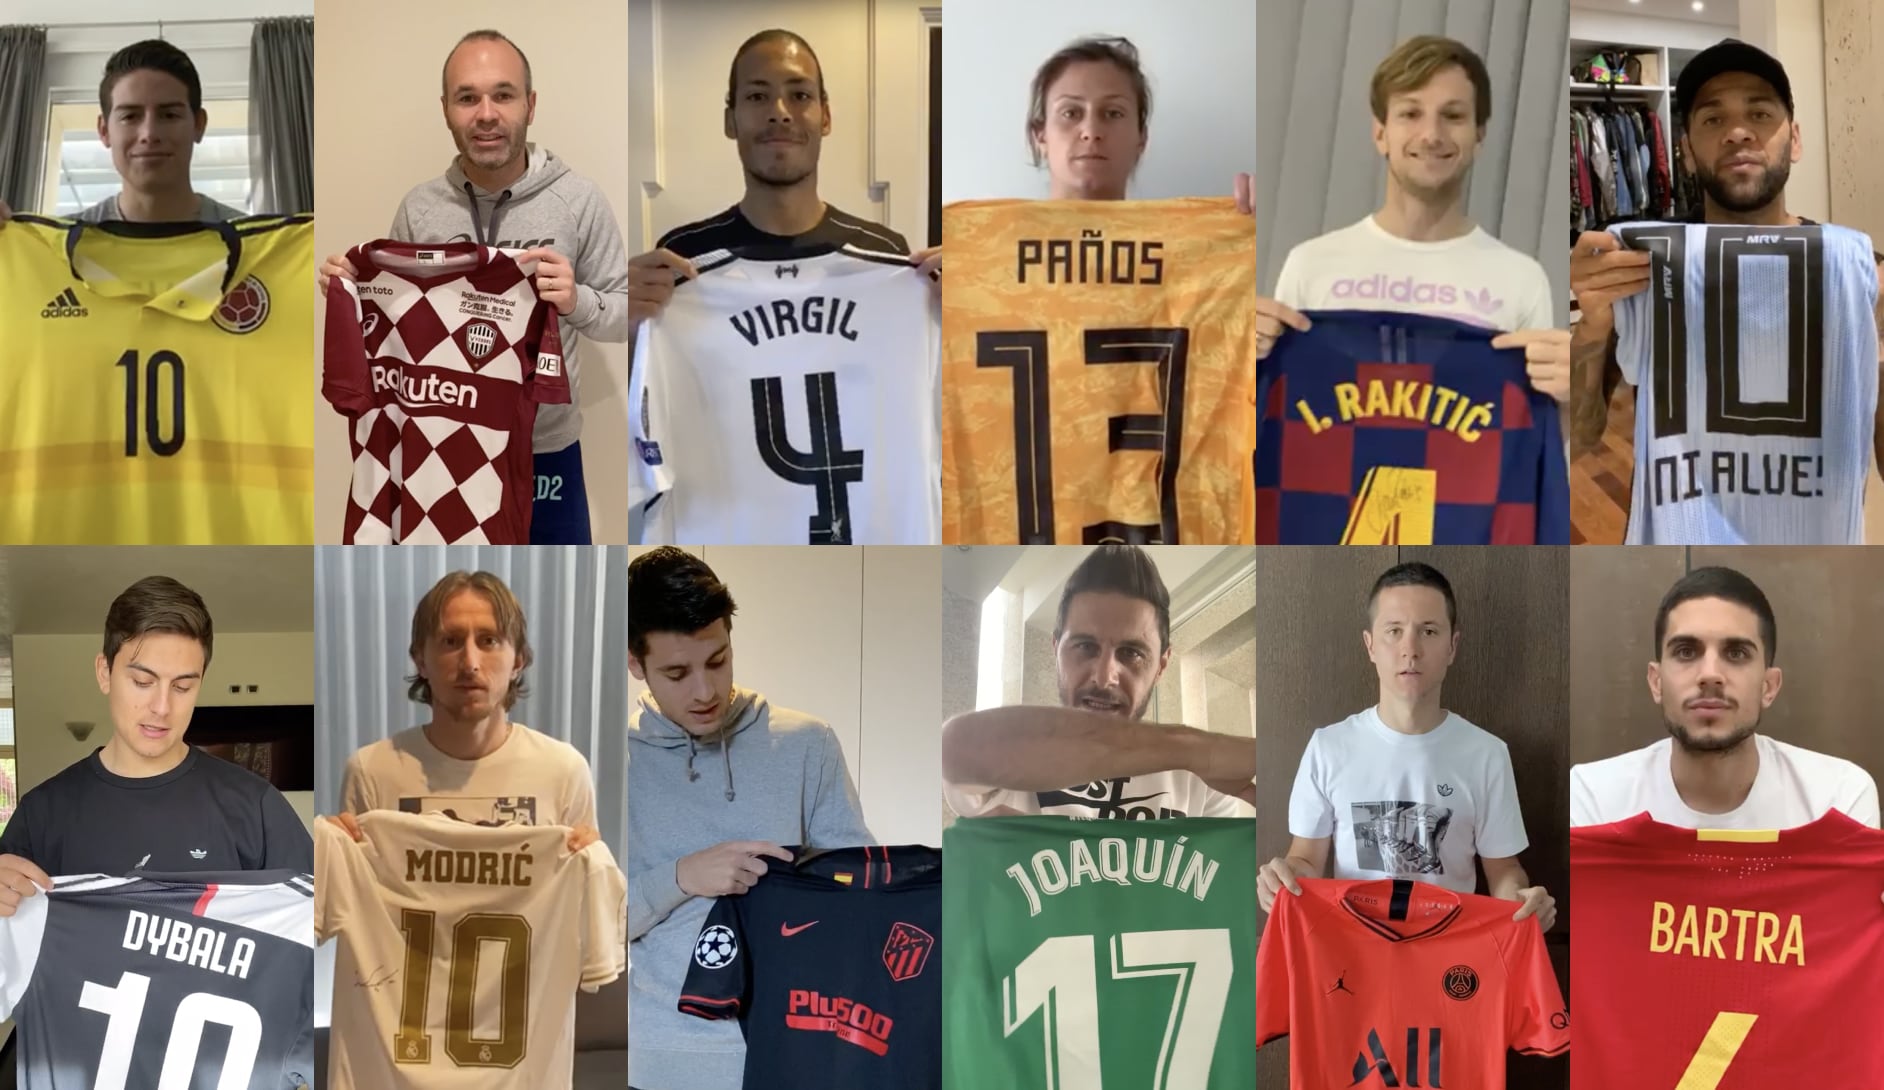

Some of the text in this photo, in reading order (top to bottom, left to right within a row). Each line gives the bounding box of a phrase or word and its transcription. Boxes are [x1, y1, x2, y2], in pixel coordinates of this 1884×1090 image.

[1018, 229, 1164, 285] PAÑOS
[1331, 273, 1458, 304] adidas
[41, 306, 89, 319] adidas
[373, 286, 394, 296] toto
[729, 296, 859, 347] VIRGIL
[115, 349, 186, 457] 10
[371, 365, 479, 409] Rakuten
[1296, 379, 1496, 443] I. RAKITIĆ
[750, 371, 865, 545] 4
[976, 327, 1190, 545] 13
[533, 474, 563, 501] D2
[404, 842, 534, 887] MODRIĆ
[1006, 835, 1220, 918] JOAQUÍN
[122, 909, 256, 980] DYBALA
[1650, 901, 1806, 967] BARTRA
[394, 907, 533, 1070] 10
[1002, 928, 1235, 1090] 17
